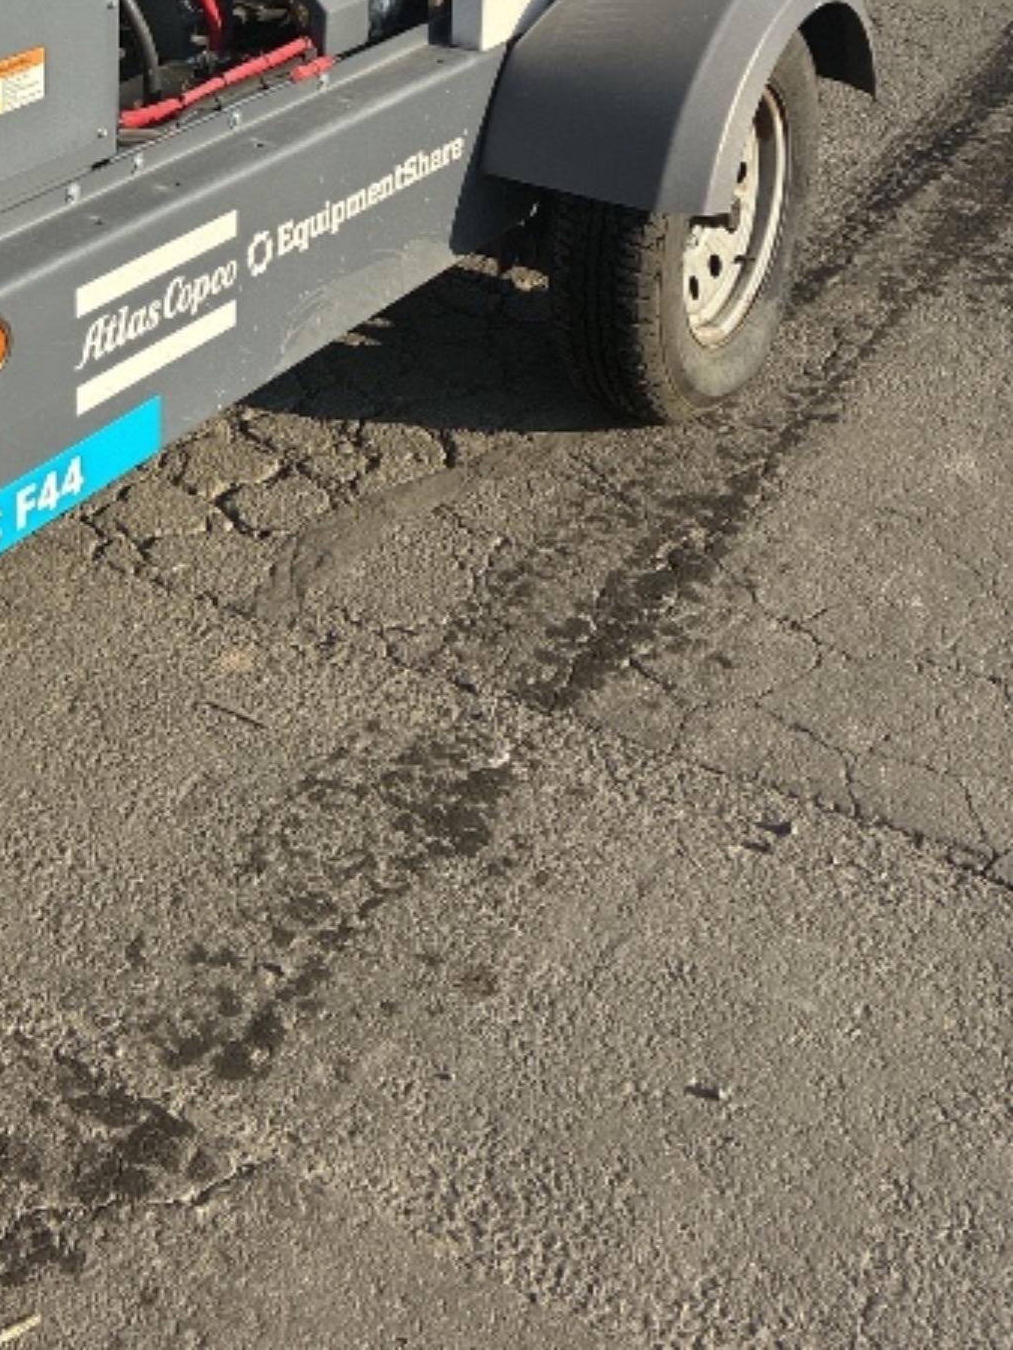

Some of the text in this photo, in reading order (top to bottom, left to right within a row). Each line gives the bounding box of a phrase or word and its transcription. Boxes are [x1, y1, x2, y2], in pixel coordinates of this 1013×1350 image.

[277, 136, 466, 252] EquipmentShare
[75, 258, 238, 371] Atlas Copco
[16, 455, 85, 531] F44
